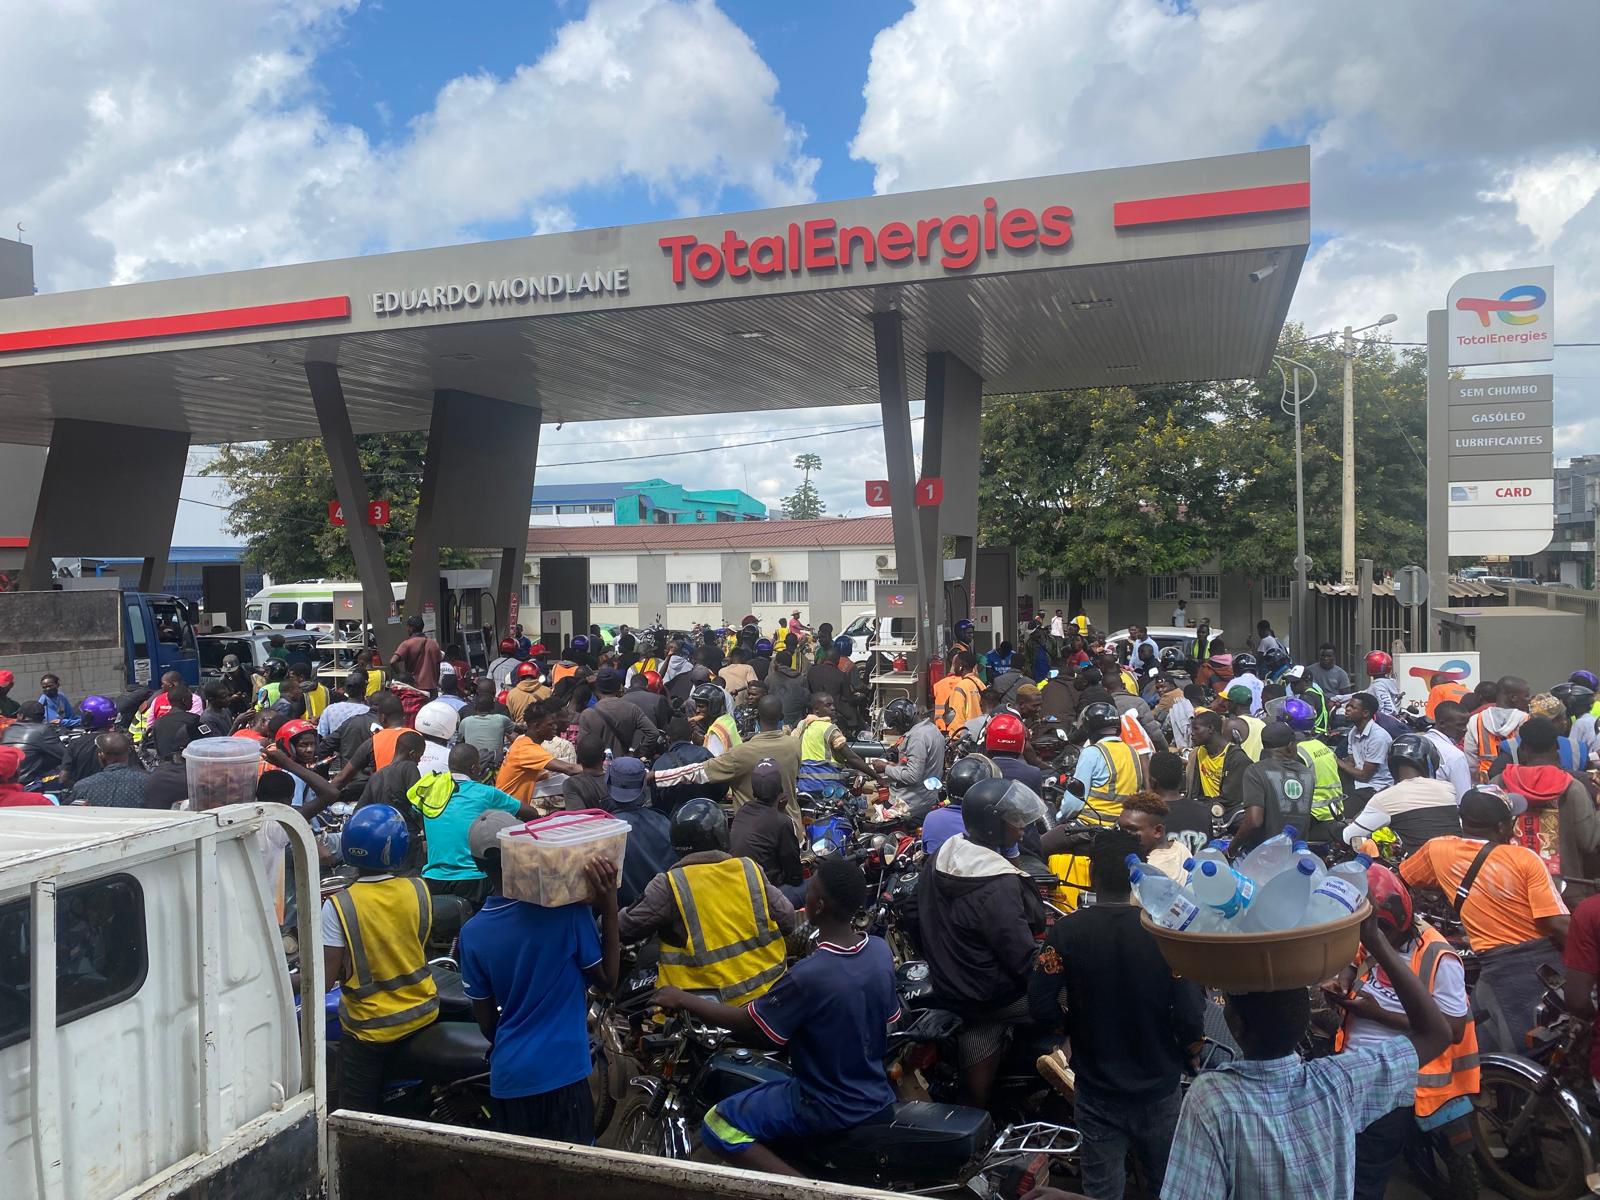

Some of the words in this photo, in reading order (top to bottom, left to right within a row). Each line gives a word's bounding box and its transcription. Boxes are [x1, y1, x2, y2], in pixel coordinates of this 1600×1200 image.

[659, 197, 1073, 284] TotalEnergies
[372, 282, 482, 314] EDUARDO
[488, 268, 630, 301] MONDLANE
[1456, 330, 1548, 346] TotalEnergies
[1460, 387, 1484, 398] SEM
[1487, 384, 1538, 396] CHUMBO
[1471, 411, 1526, 423] GASÓLEO
[1455, 435, 1543, 448] LUBRIFICANTES
[873, 486, 884, 502] 2
[925, 484, 934, 500] 1
[1495, 487, 1532, 498] CARD
[335, 506, 344, 520] 4
[374, 505, 382, 520] 3
